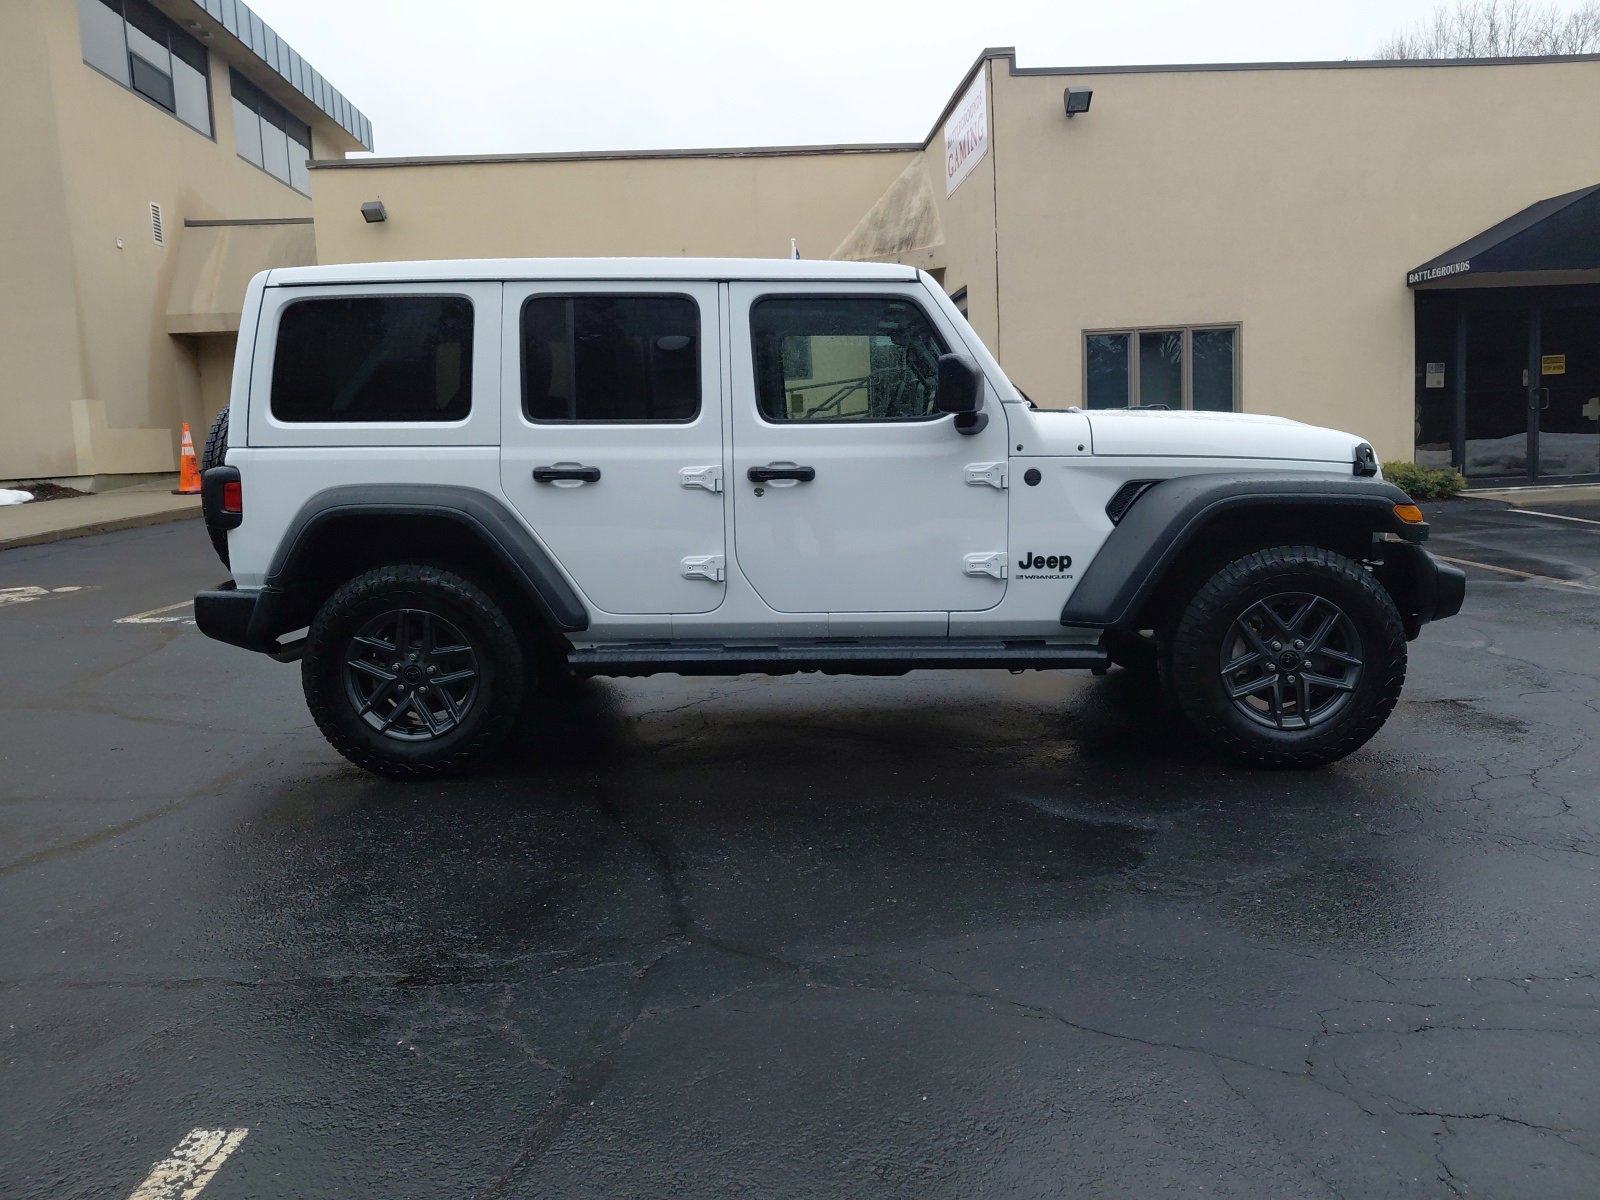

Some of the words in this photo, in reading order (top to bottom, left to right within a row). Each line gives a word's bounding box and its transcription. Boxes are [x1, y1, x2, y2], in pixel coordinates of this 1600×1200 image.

[947, 112, 985, 178] GAMING
[1409, 260, 1470, 283] BATTLEGROUNDS
[1018, 551, 1072, 572] Jeep
